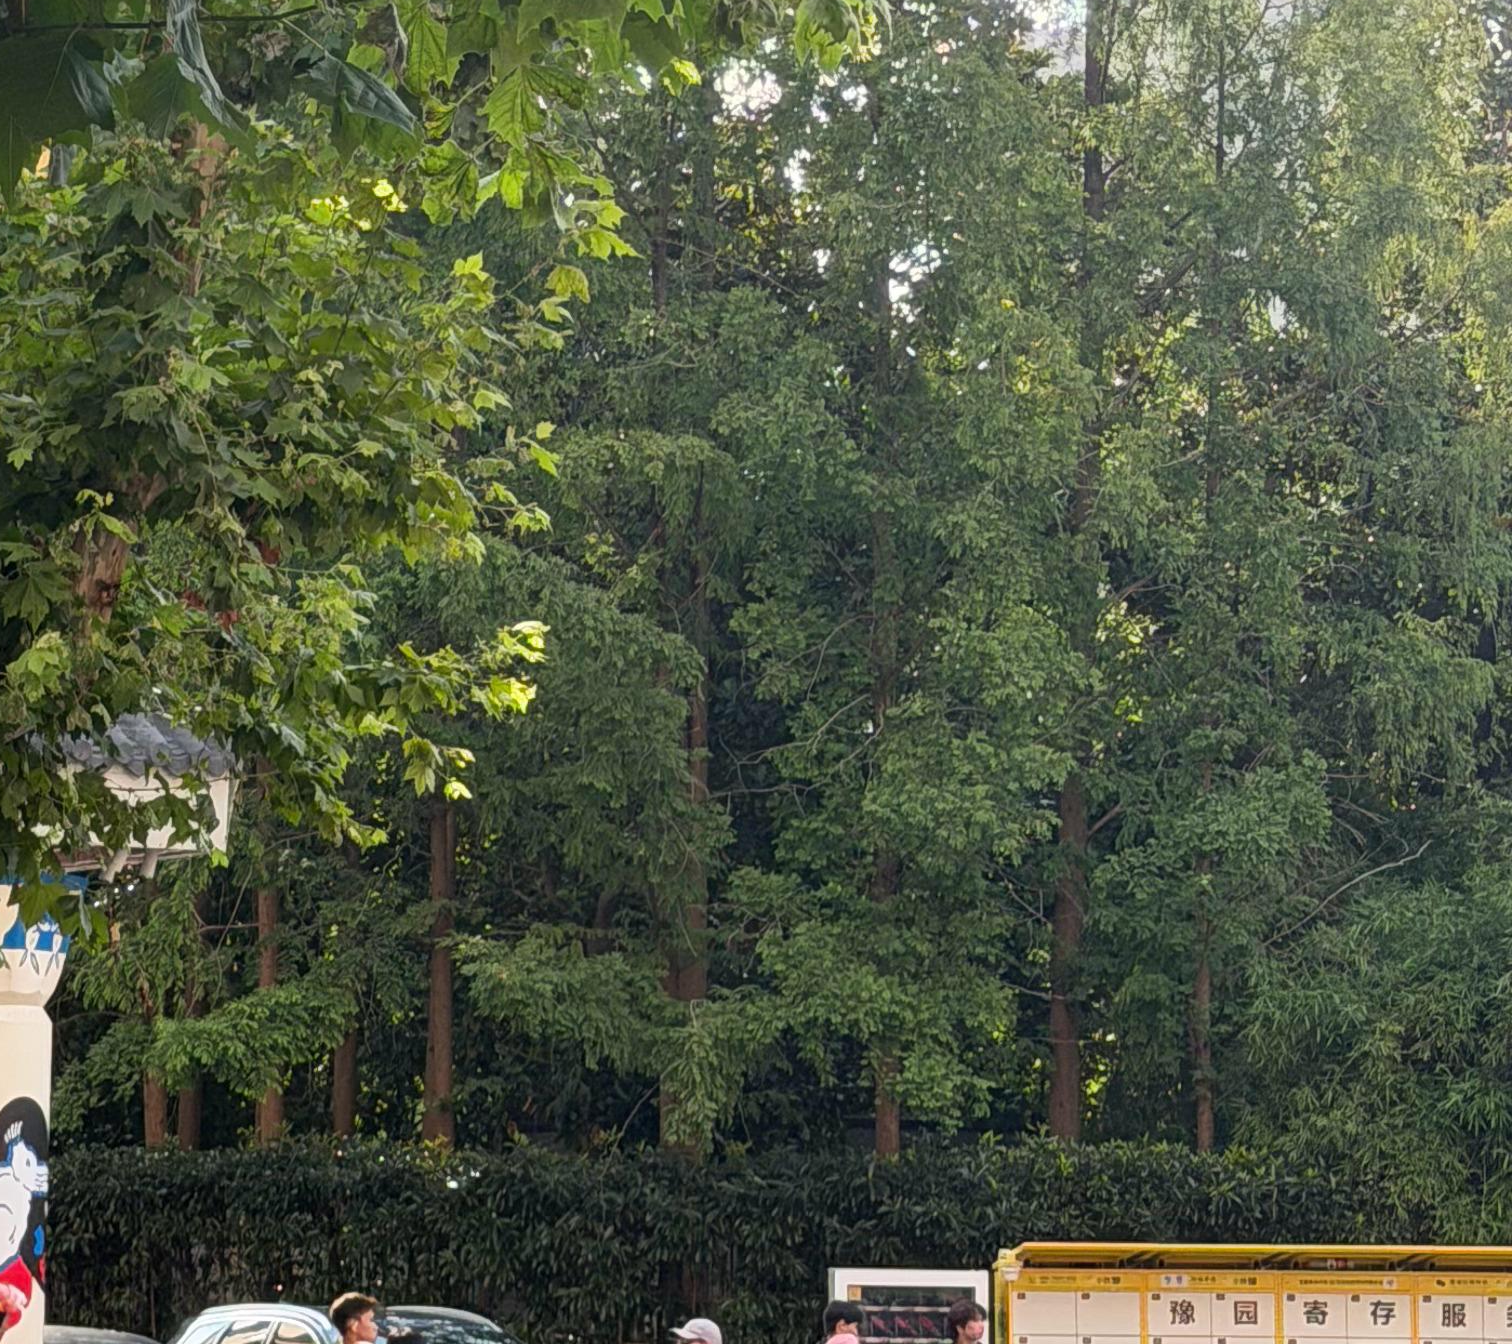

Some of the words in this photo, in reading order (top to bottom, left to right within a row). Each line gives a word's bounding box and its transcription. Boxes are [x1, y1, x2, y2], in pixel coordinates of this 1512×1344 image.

[1170, 1298, 1512, 1329] 豫园寄存服
